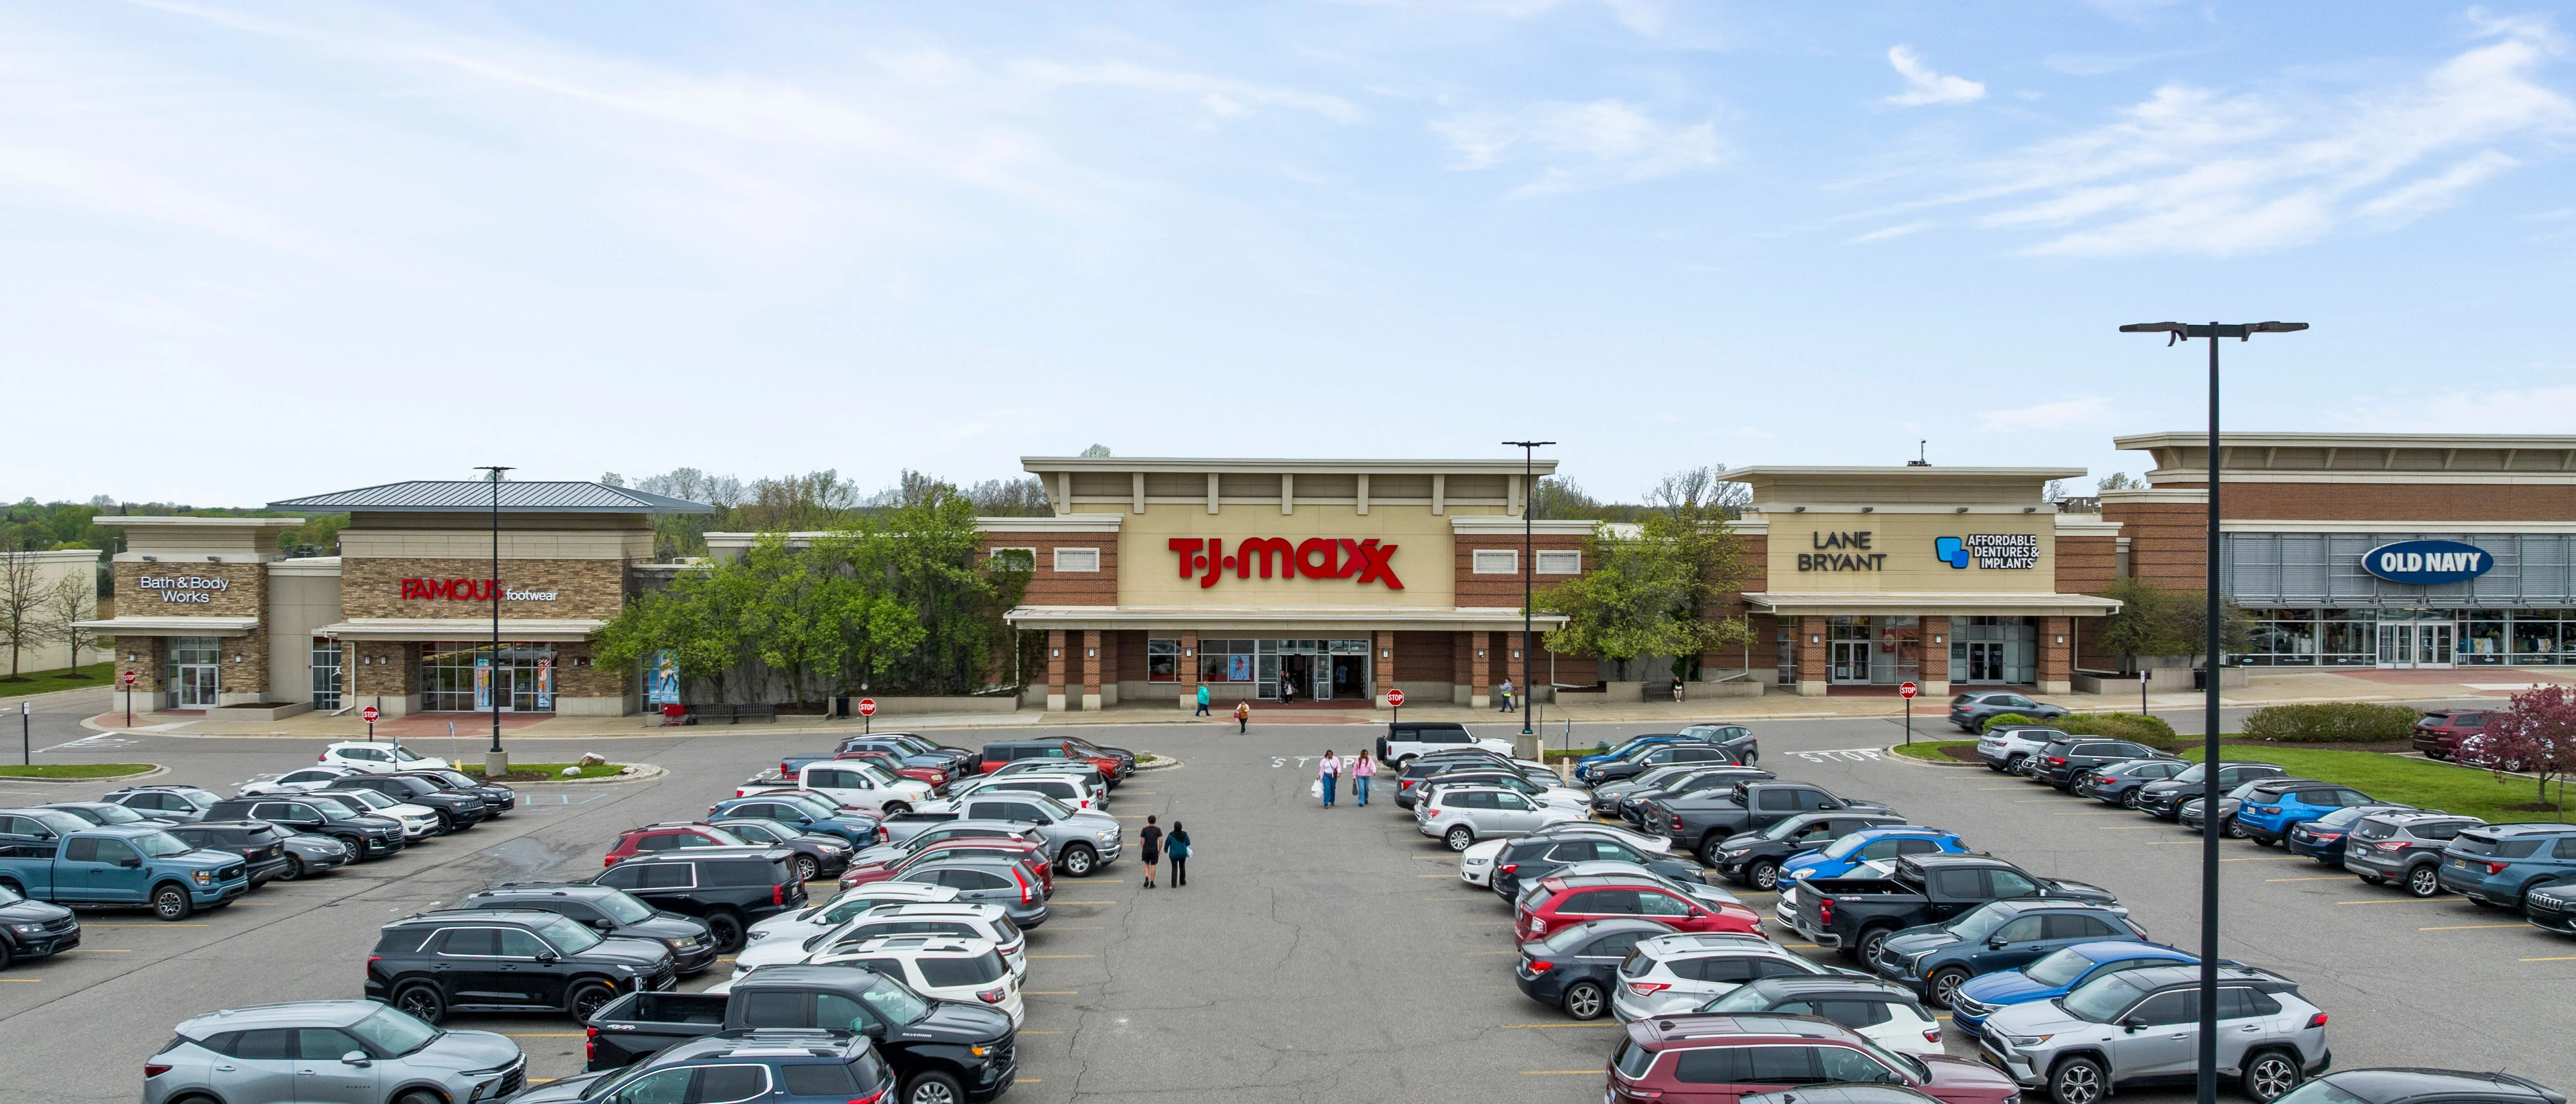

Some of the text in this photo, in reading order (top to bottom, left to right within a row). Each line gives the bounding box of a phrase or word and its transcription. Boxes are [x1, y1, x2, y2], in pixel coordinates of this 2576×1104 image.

[1814, 531, 1871, 549] LANE
[1968, 535, 2036, 546] AFFORDABLE
[1975, 546, 2040, 557] DENTURES &
[1798, 553, 1887, 571] BRYANT
[1981, 558, 2034, 568] IMPLANTS
[2381, 553, 2481, 572] OLD NAVY
[141, 576, 229, 592] Bath & Body
[401, 578, 558, 601] FAMOUS footwear
[161, 590, 210, 603] Works
[1271, 758, 1355, 768] STP
[1798, 751, 1881, 763] STOP
